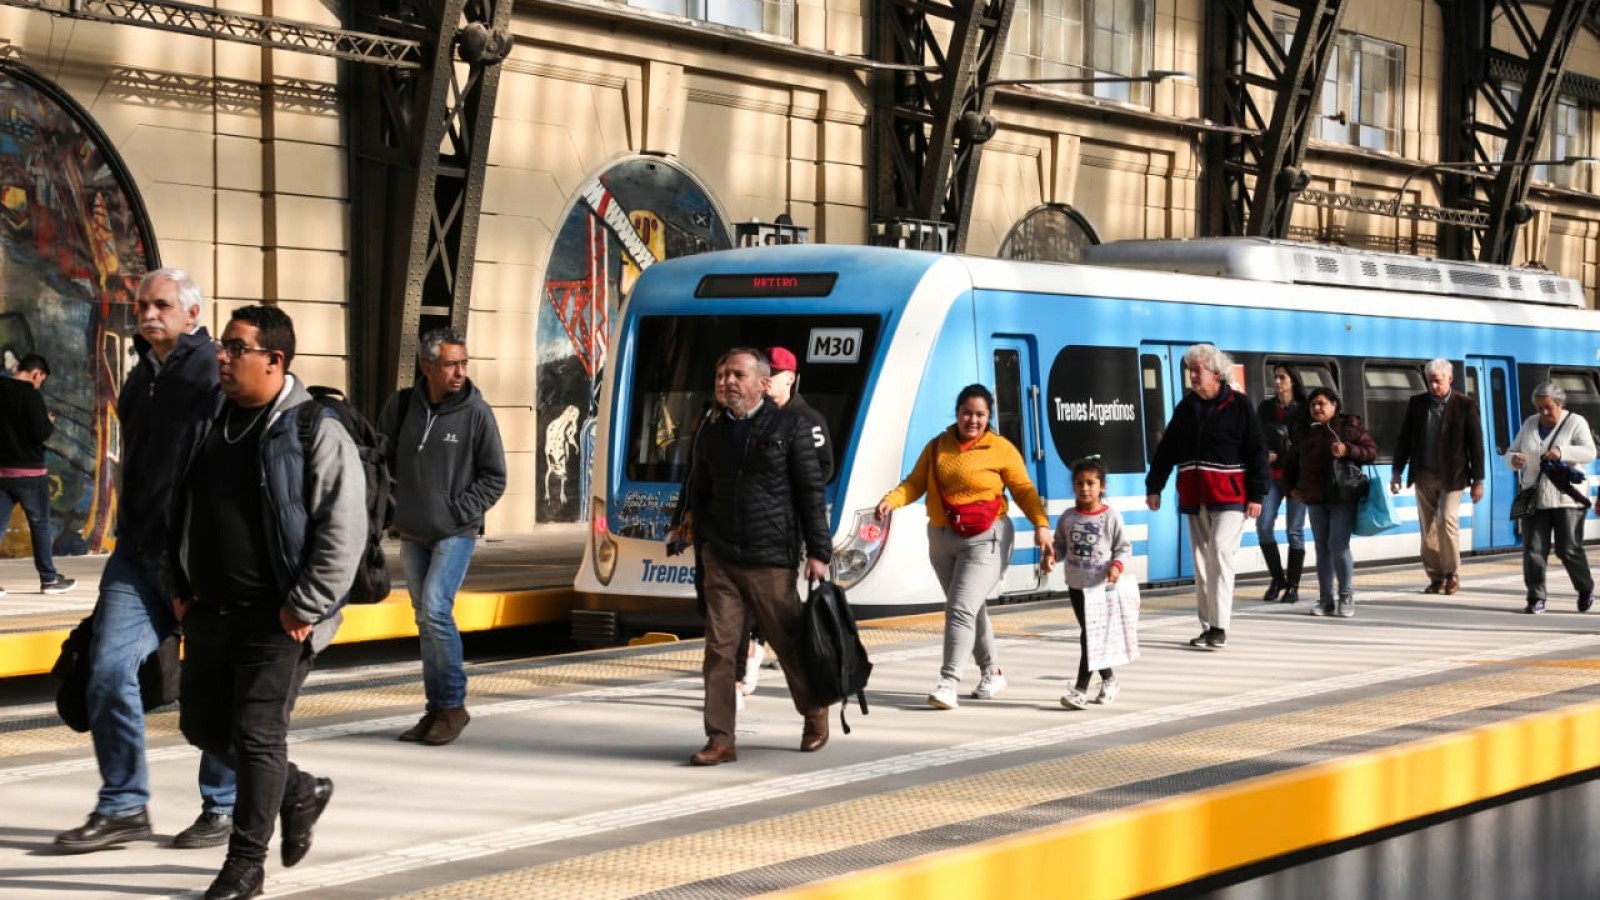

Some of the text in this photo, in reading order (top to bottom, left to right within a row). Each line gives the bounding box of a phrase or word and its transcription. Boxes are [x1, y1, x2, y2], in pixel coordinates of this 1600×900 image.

[814, 336, 855, 356] M30
[1054, 397, 1136, 426] Trenes Argentinos
[642, 559, 697, 584] Trenes
